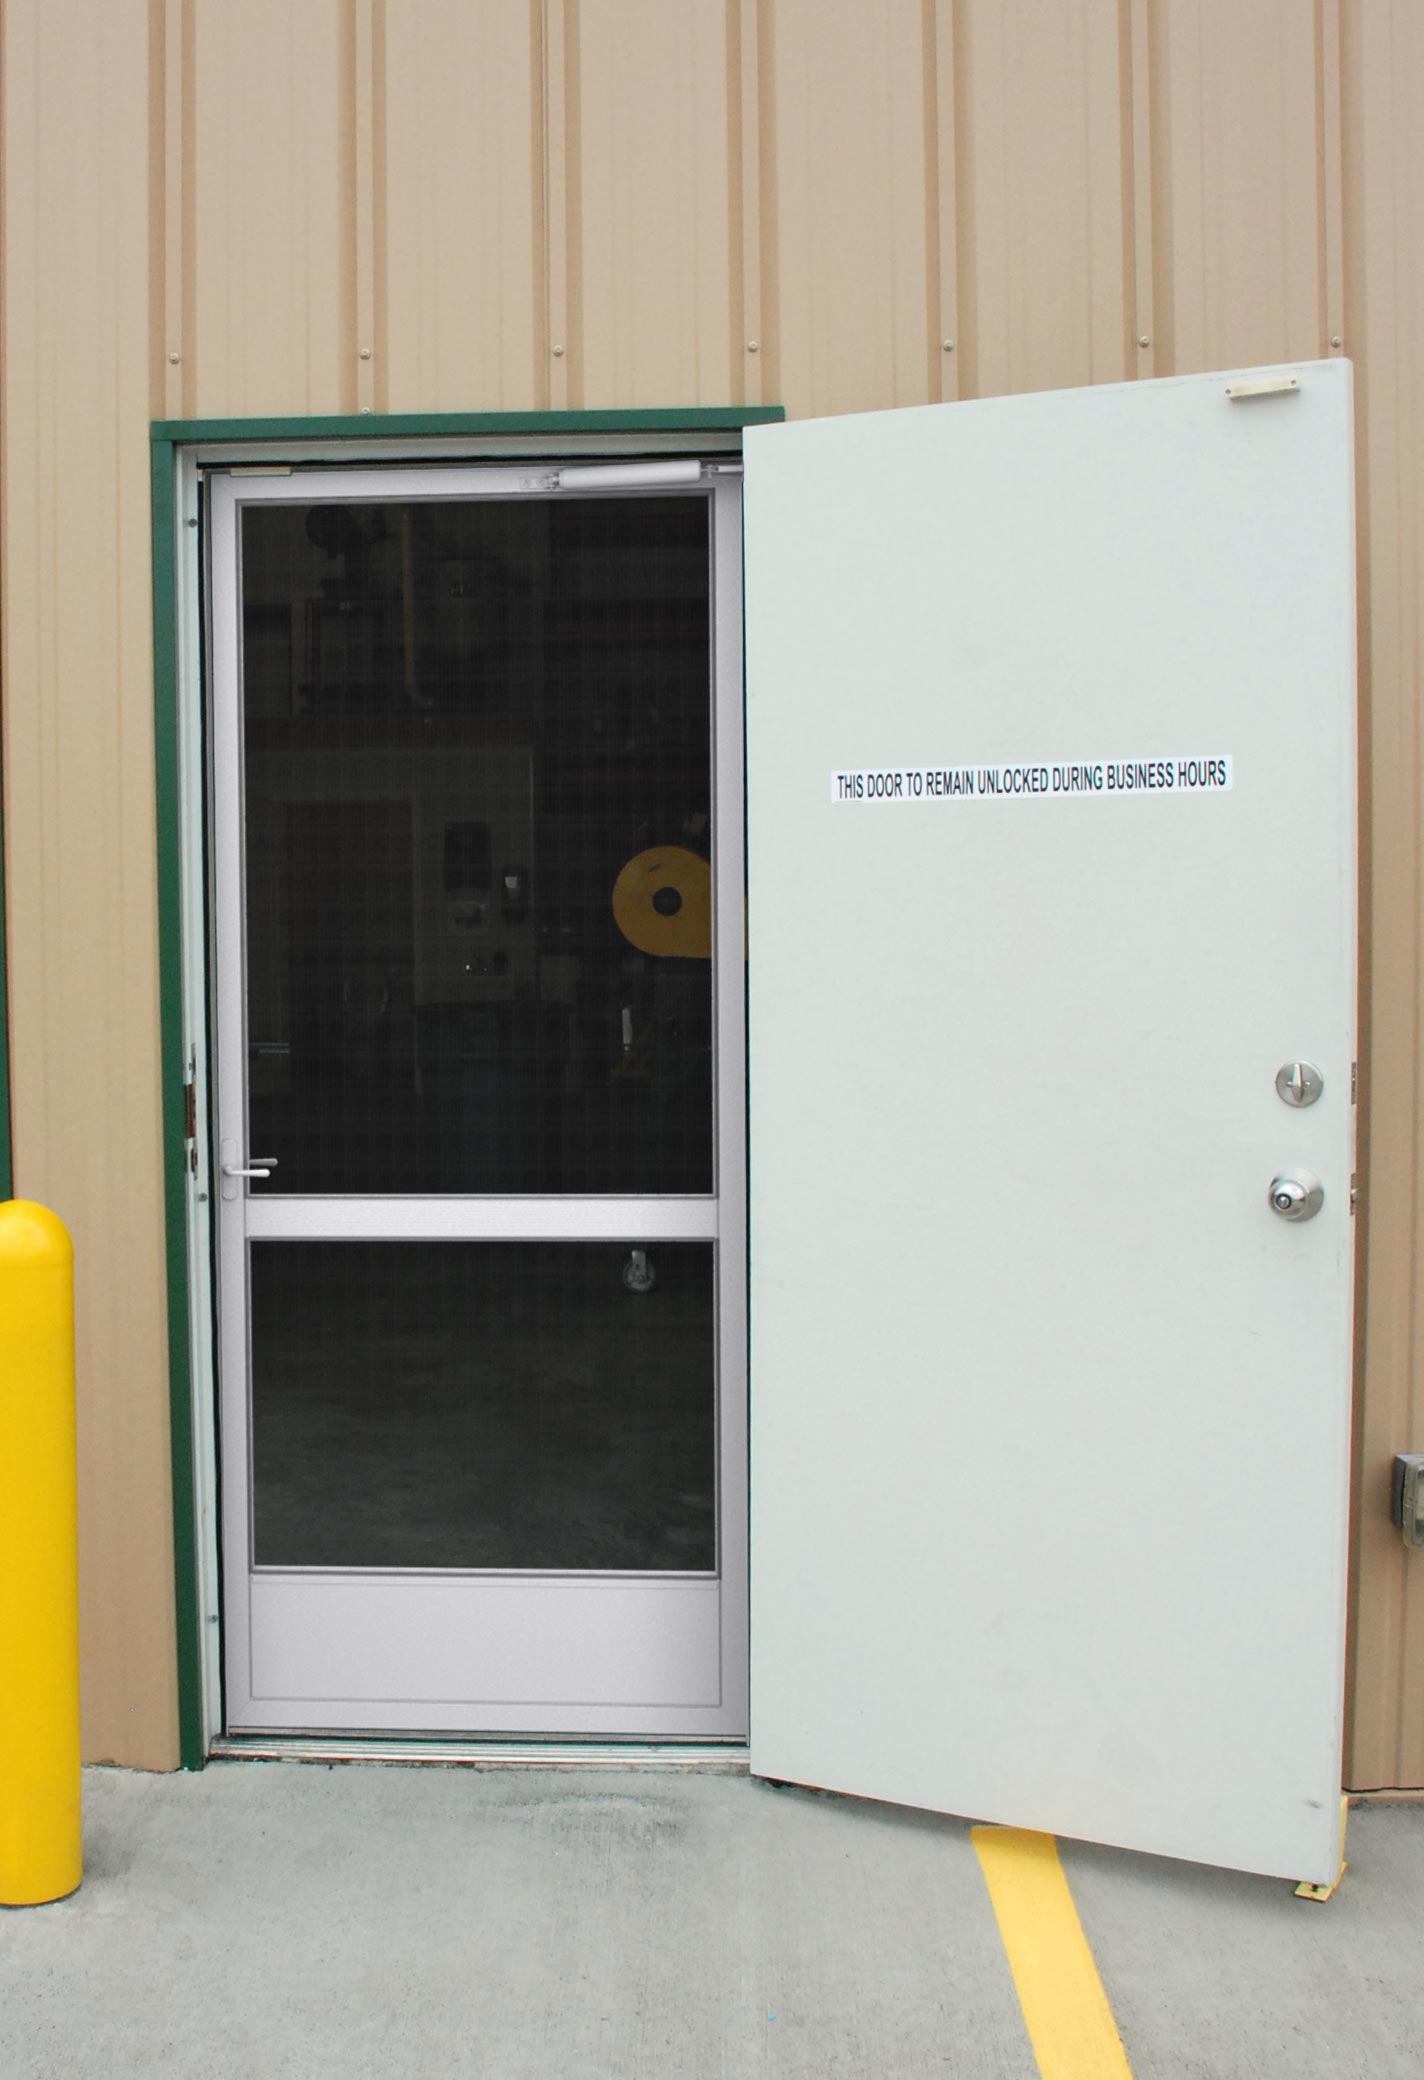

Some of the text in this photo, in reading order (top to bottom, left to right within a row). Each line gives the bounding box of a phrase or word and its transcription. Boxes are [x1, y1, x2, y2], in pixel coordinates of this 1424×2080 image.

[838, 760, 1227, 799] THIS DOOR TO REMAIN UNLOCKED DURING BUSINESS HOURS
